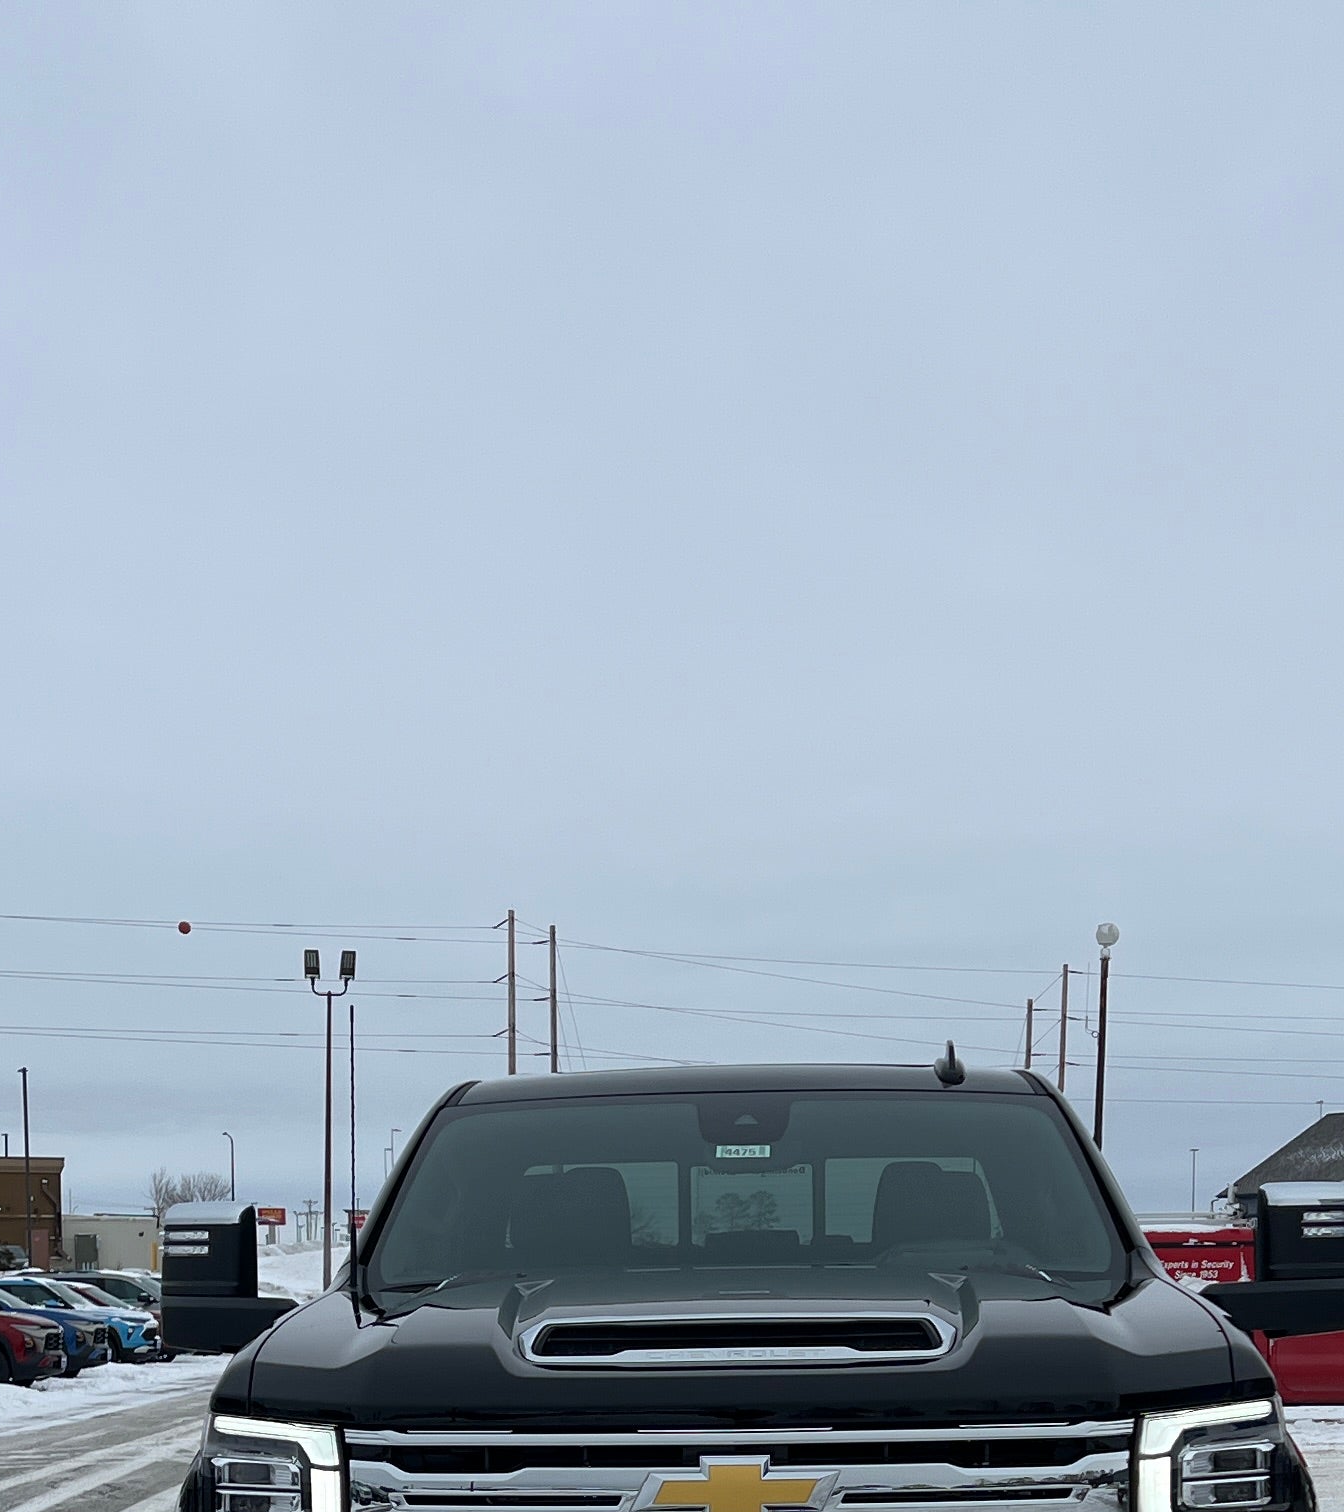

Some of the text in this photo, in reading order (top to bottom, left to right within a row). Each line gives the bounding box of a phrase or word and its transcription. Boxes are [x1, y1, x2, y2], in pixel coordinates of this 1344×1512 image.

[724, 1148, 756, 1157] 4475
[1190, 1260, 1199, 1269] in
[1200, 1260, 1234, 1270] Security
[1199, 1270, 1219, 1279] 1953
[646, 1349, 826, 1360] CHEVROLET
